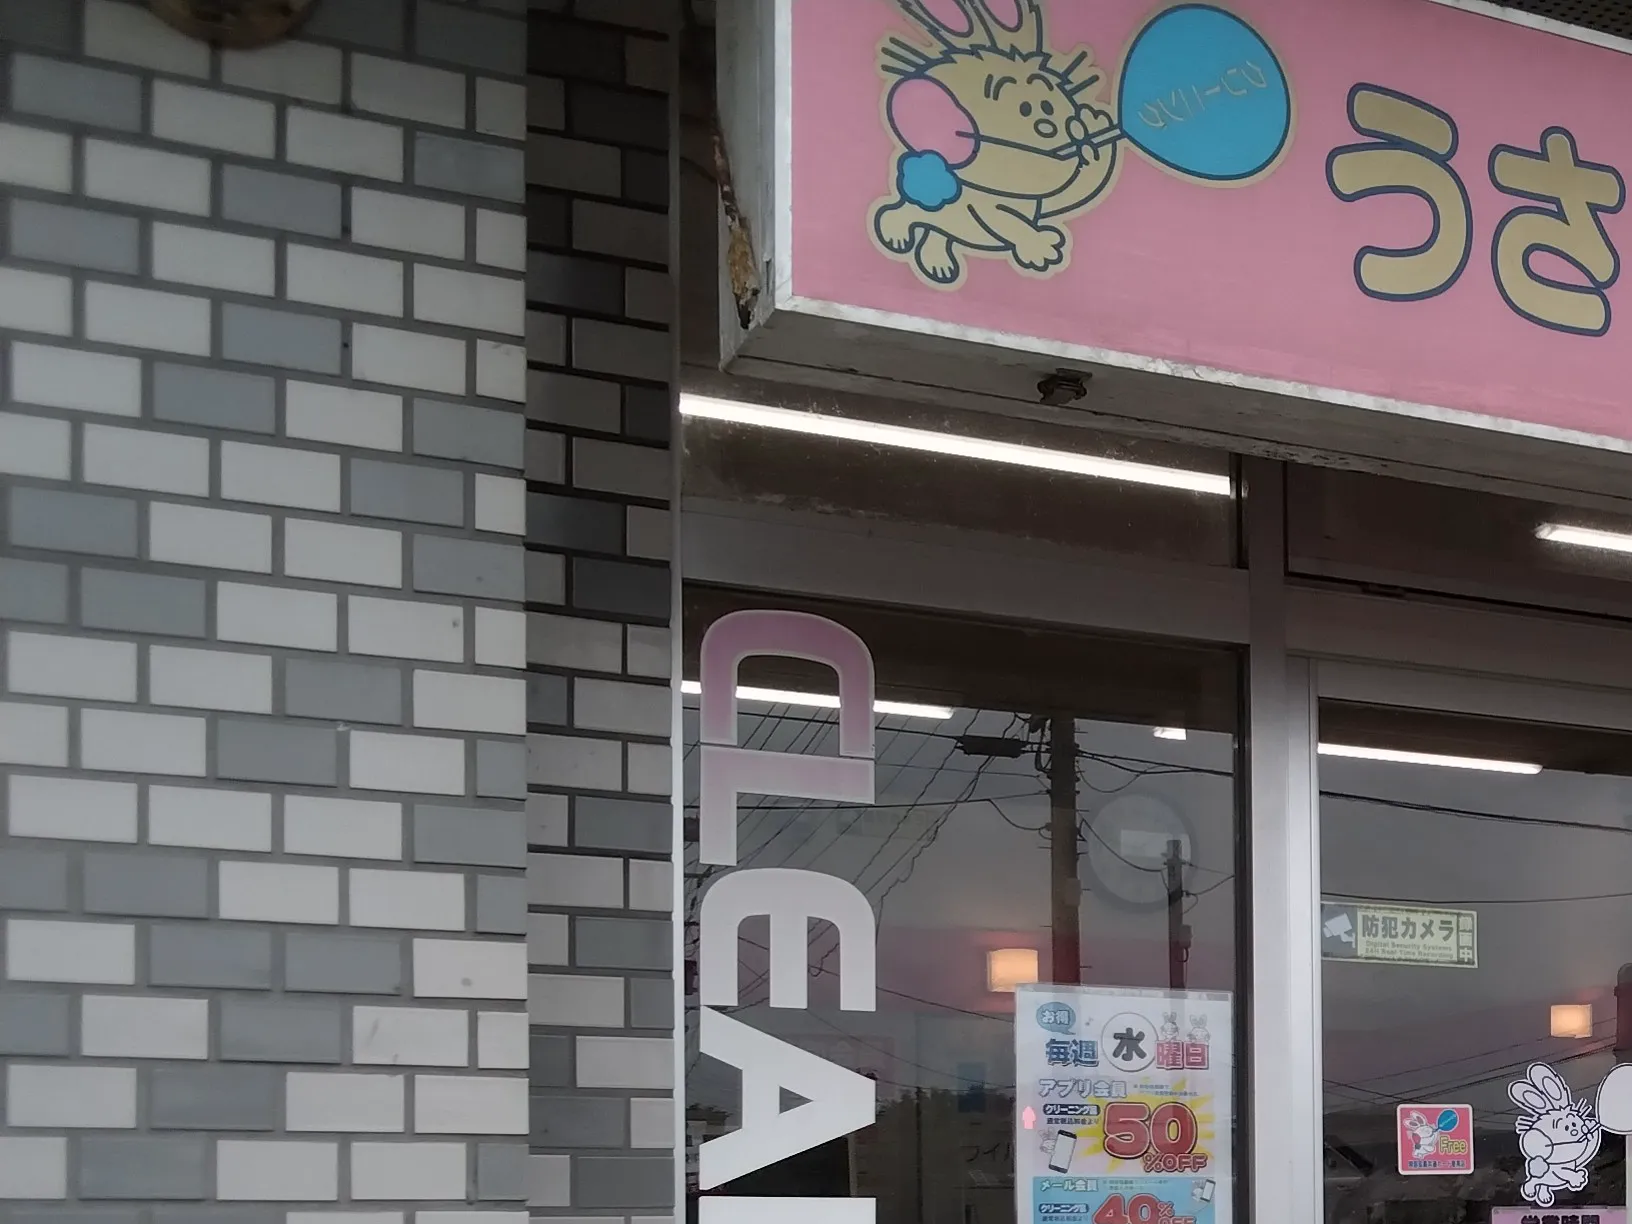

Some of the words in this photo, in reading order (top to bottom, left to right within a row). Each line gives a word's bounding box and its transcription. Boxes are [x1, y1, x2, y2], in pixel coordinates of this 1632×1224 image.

[1361, 913, 1454, 942] 防犯カメラ
[1038, 1077, 1128, 1099] アプリ会員
[1103, 1101, 1198, 1159] 50
[1439, 1134, 1467, 1154] Free
[1143, 1153, 1208, 1173] %OFF
[1040, 1179, 1099, 1192] メール会員
